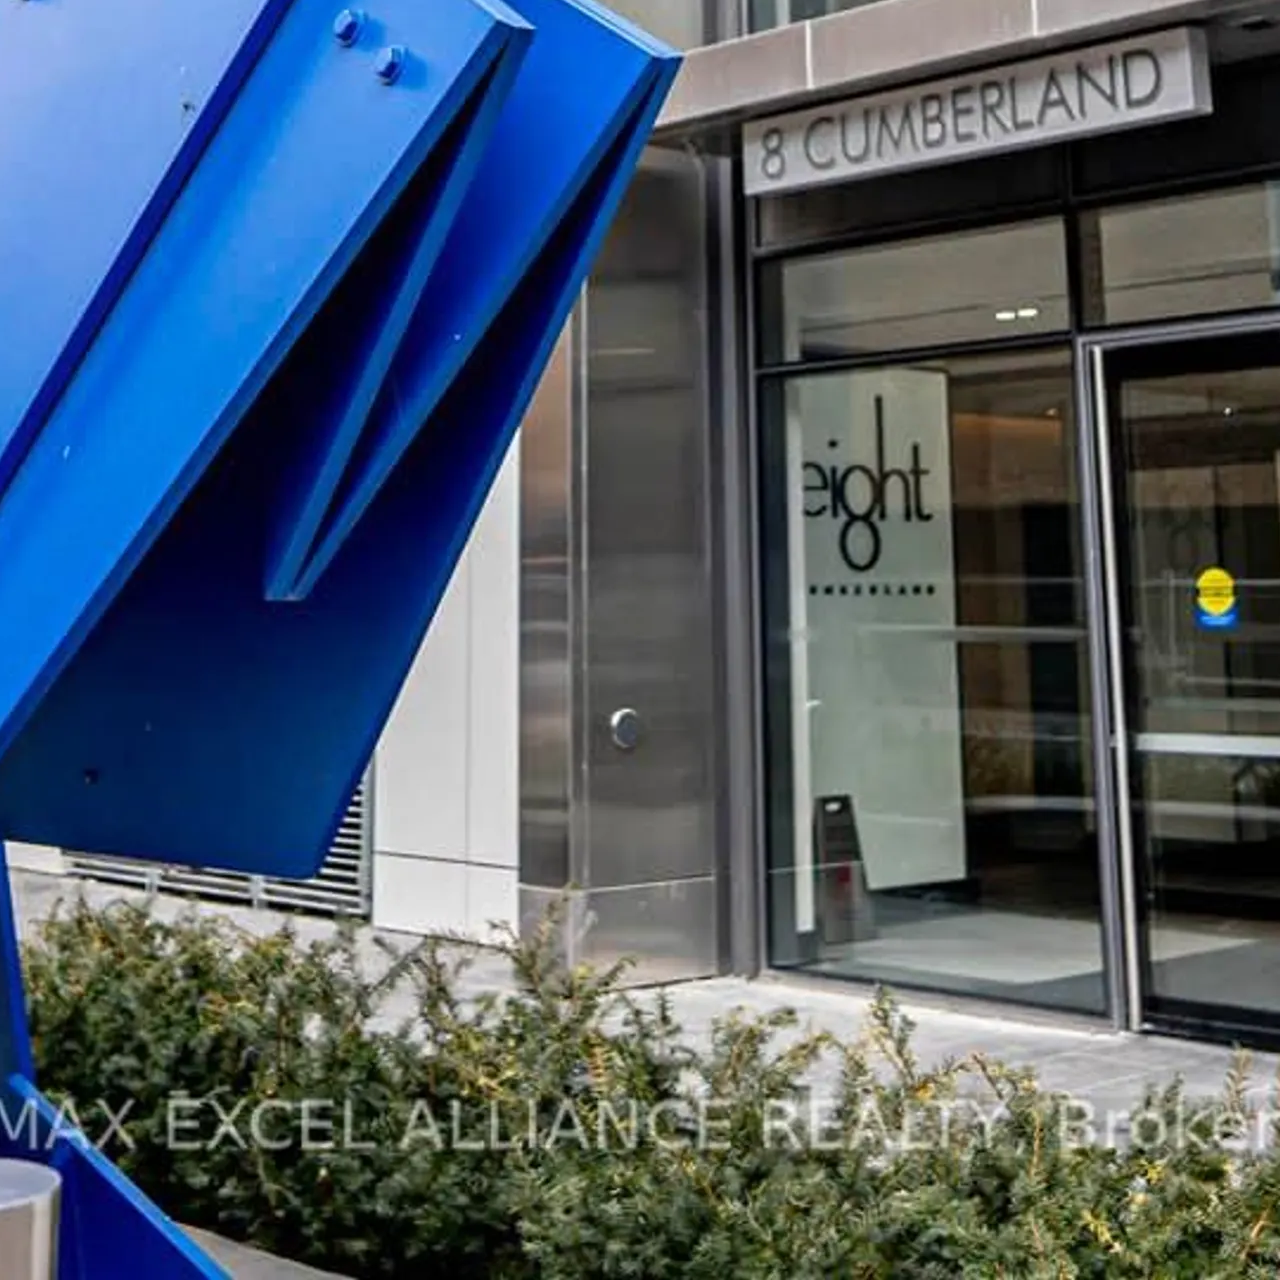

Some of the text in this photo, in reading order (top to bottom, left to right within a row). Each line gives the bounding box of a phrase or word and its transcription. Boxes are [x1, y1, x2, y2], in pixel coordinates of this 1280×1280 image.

[760, 47, 1163, 180] 8 CUMBERLAND
[802, 394, 934, 572] eight
